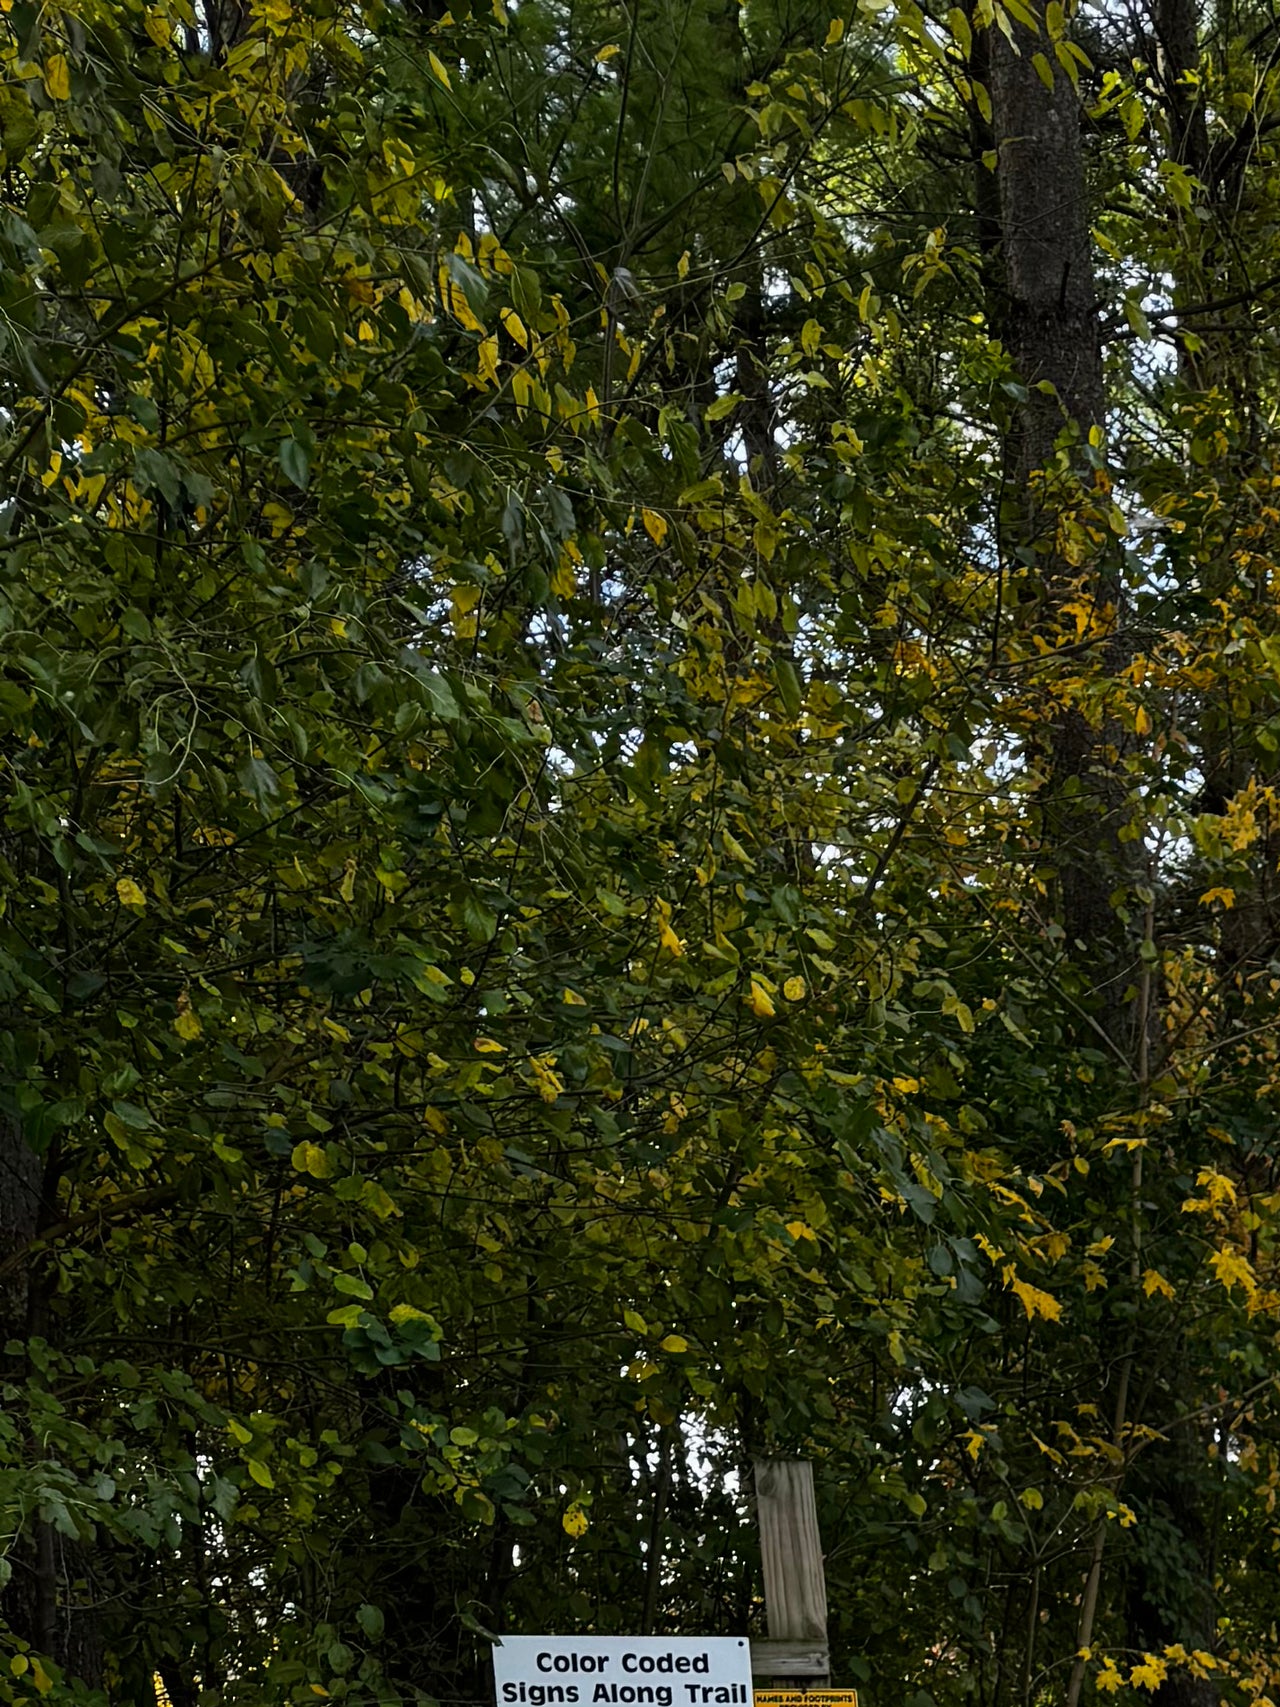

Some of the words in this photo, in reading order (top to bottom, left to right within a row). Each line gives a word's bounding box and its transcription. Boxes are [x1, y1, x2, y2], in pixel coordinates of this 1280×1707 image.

[536, 1652, 610, 1673] Color
[621, 1653, 710, 1674] Coded
[502, 1682, 580, 1706] Signs
[592, 1683, 673, 1707] Along
[684, 1683, 747, 1704] Trail
